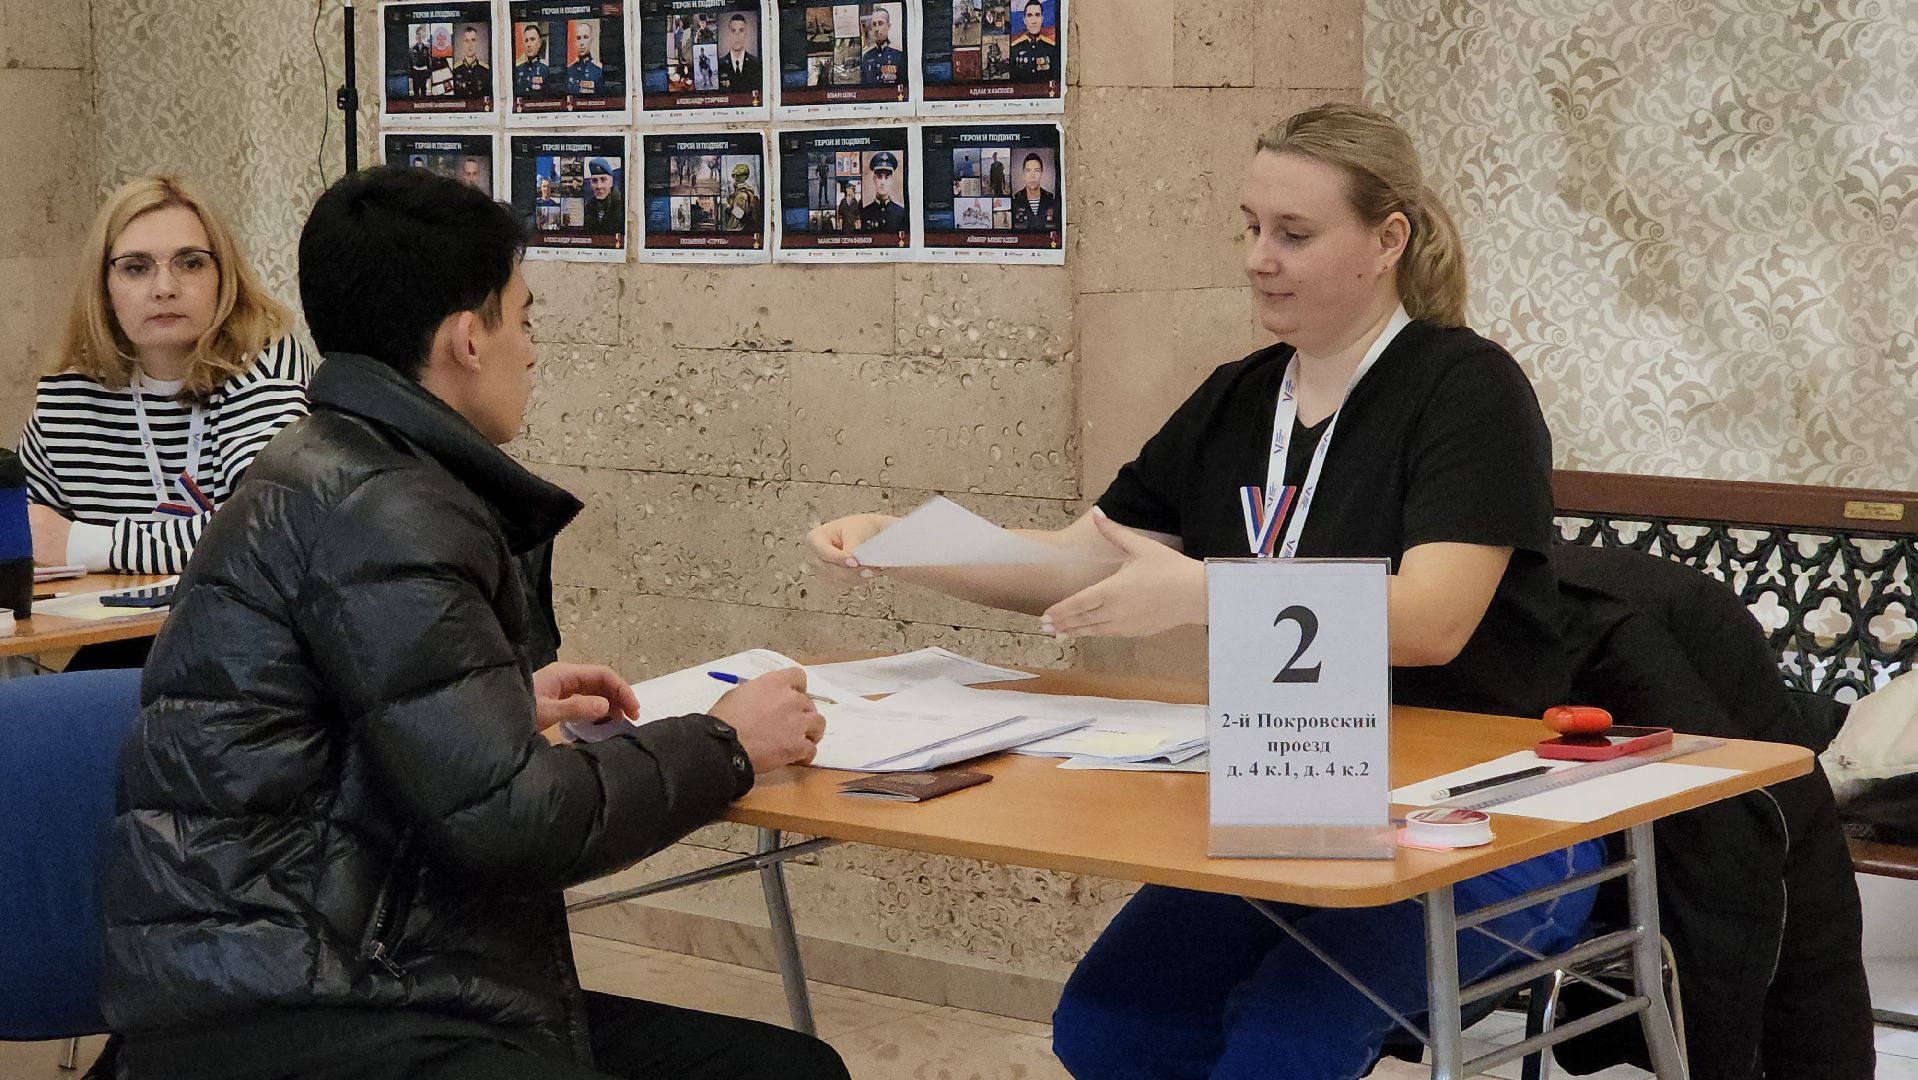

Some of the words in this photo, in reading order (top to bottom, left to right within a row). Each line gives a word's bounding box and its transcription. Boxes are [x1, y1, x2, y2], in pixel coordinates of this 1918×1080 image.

[814, 139, 834, 147] ГЕРОИ
[835, 138, 840, 146] И
[841, 137, 871, 146] ПОДВИГИ
[960, 134, 981, 142] ГЕРОИ
[989, 133, 1021, 142] ПОДВИГИ
[677, 142, 695, 150] ГЕРОИ
[701, 141, 729, 150] ПОДВИГИ
[1272, 605, 1322, 683] 2
[1220, 713, 1250, 729] 2-й
[1257, 713, 1377, 732] Покровский
[1267, 741, 1331, 756] проезд
[1226, 765, 1243, 778] д.
[1249, 762, 1259, 777] 4
[1265, 762, 1299, 778] к.1,
[1304, 765, 1320, 778] д.
[1325, 762, 1335, 777] 4
[1342, 762, 1369, 777] к.2
